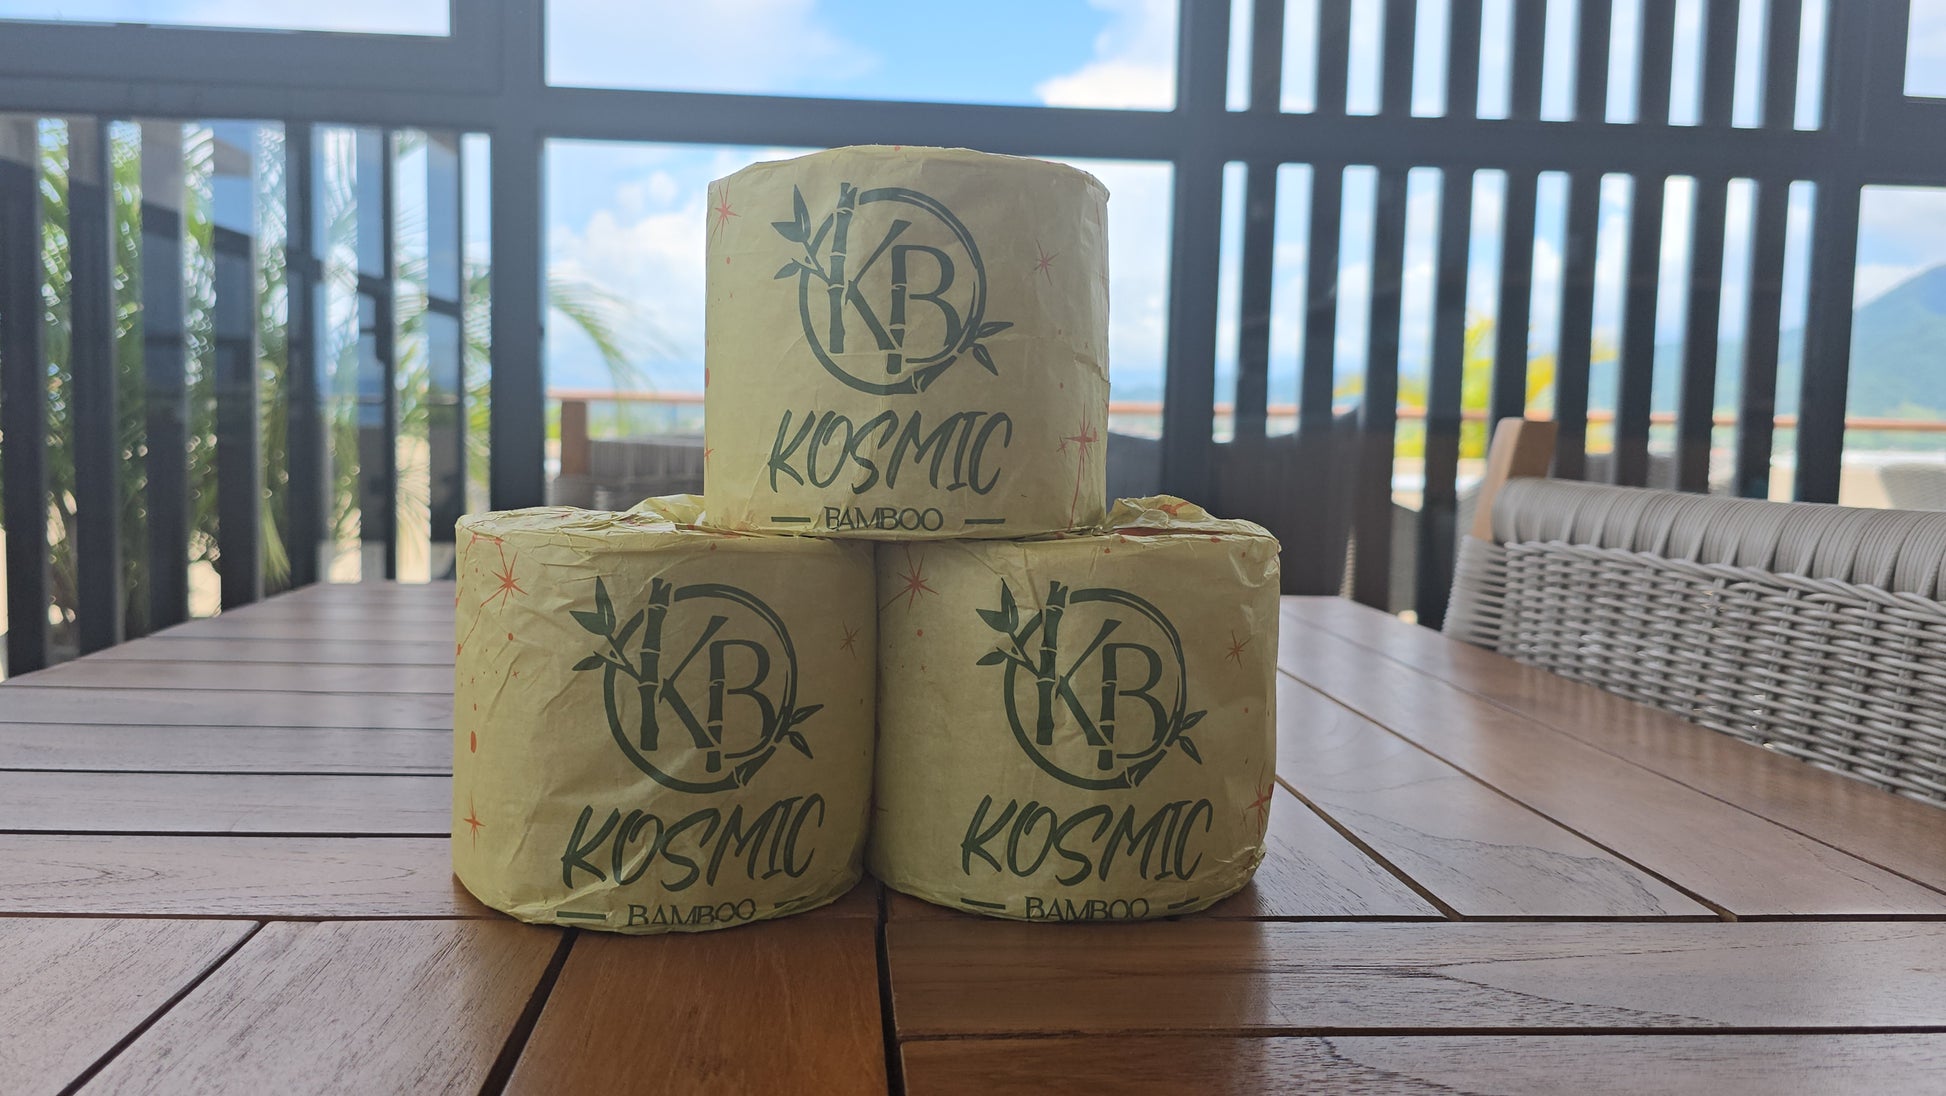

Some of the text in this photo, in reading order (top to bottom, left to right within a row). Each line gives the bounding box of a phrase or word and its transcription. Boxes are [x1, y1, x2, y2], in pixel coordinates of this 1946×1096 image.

[828, 183, 962, 374] KB
[768, 409, 1013, 495] KOSMIC
[824, 506, 944, 532] BAMBOO
[638, 578, 777, 773] KB
[1036, 581, 1168, 770] KB
[561, 793, 825, 892] KOSMIC
[961, 795, 1213, 886] KOSMIC
[628, 898, 757, 926] BAMBOO
[1025, 897, 1150, 921] BAMBOO
